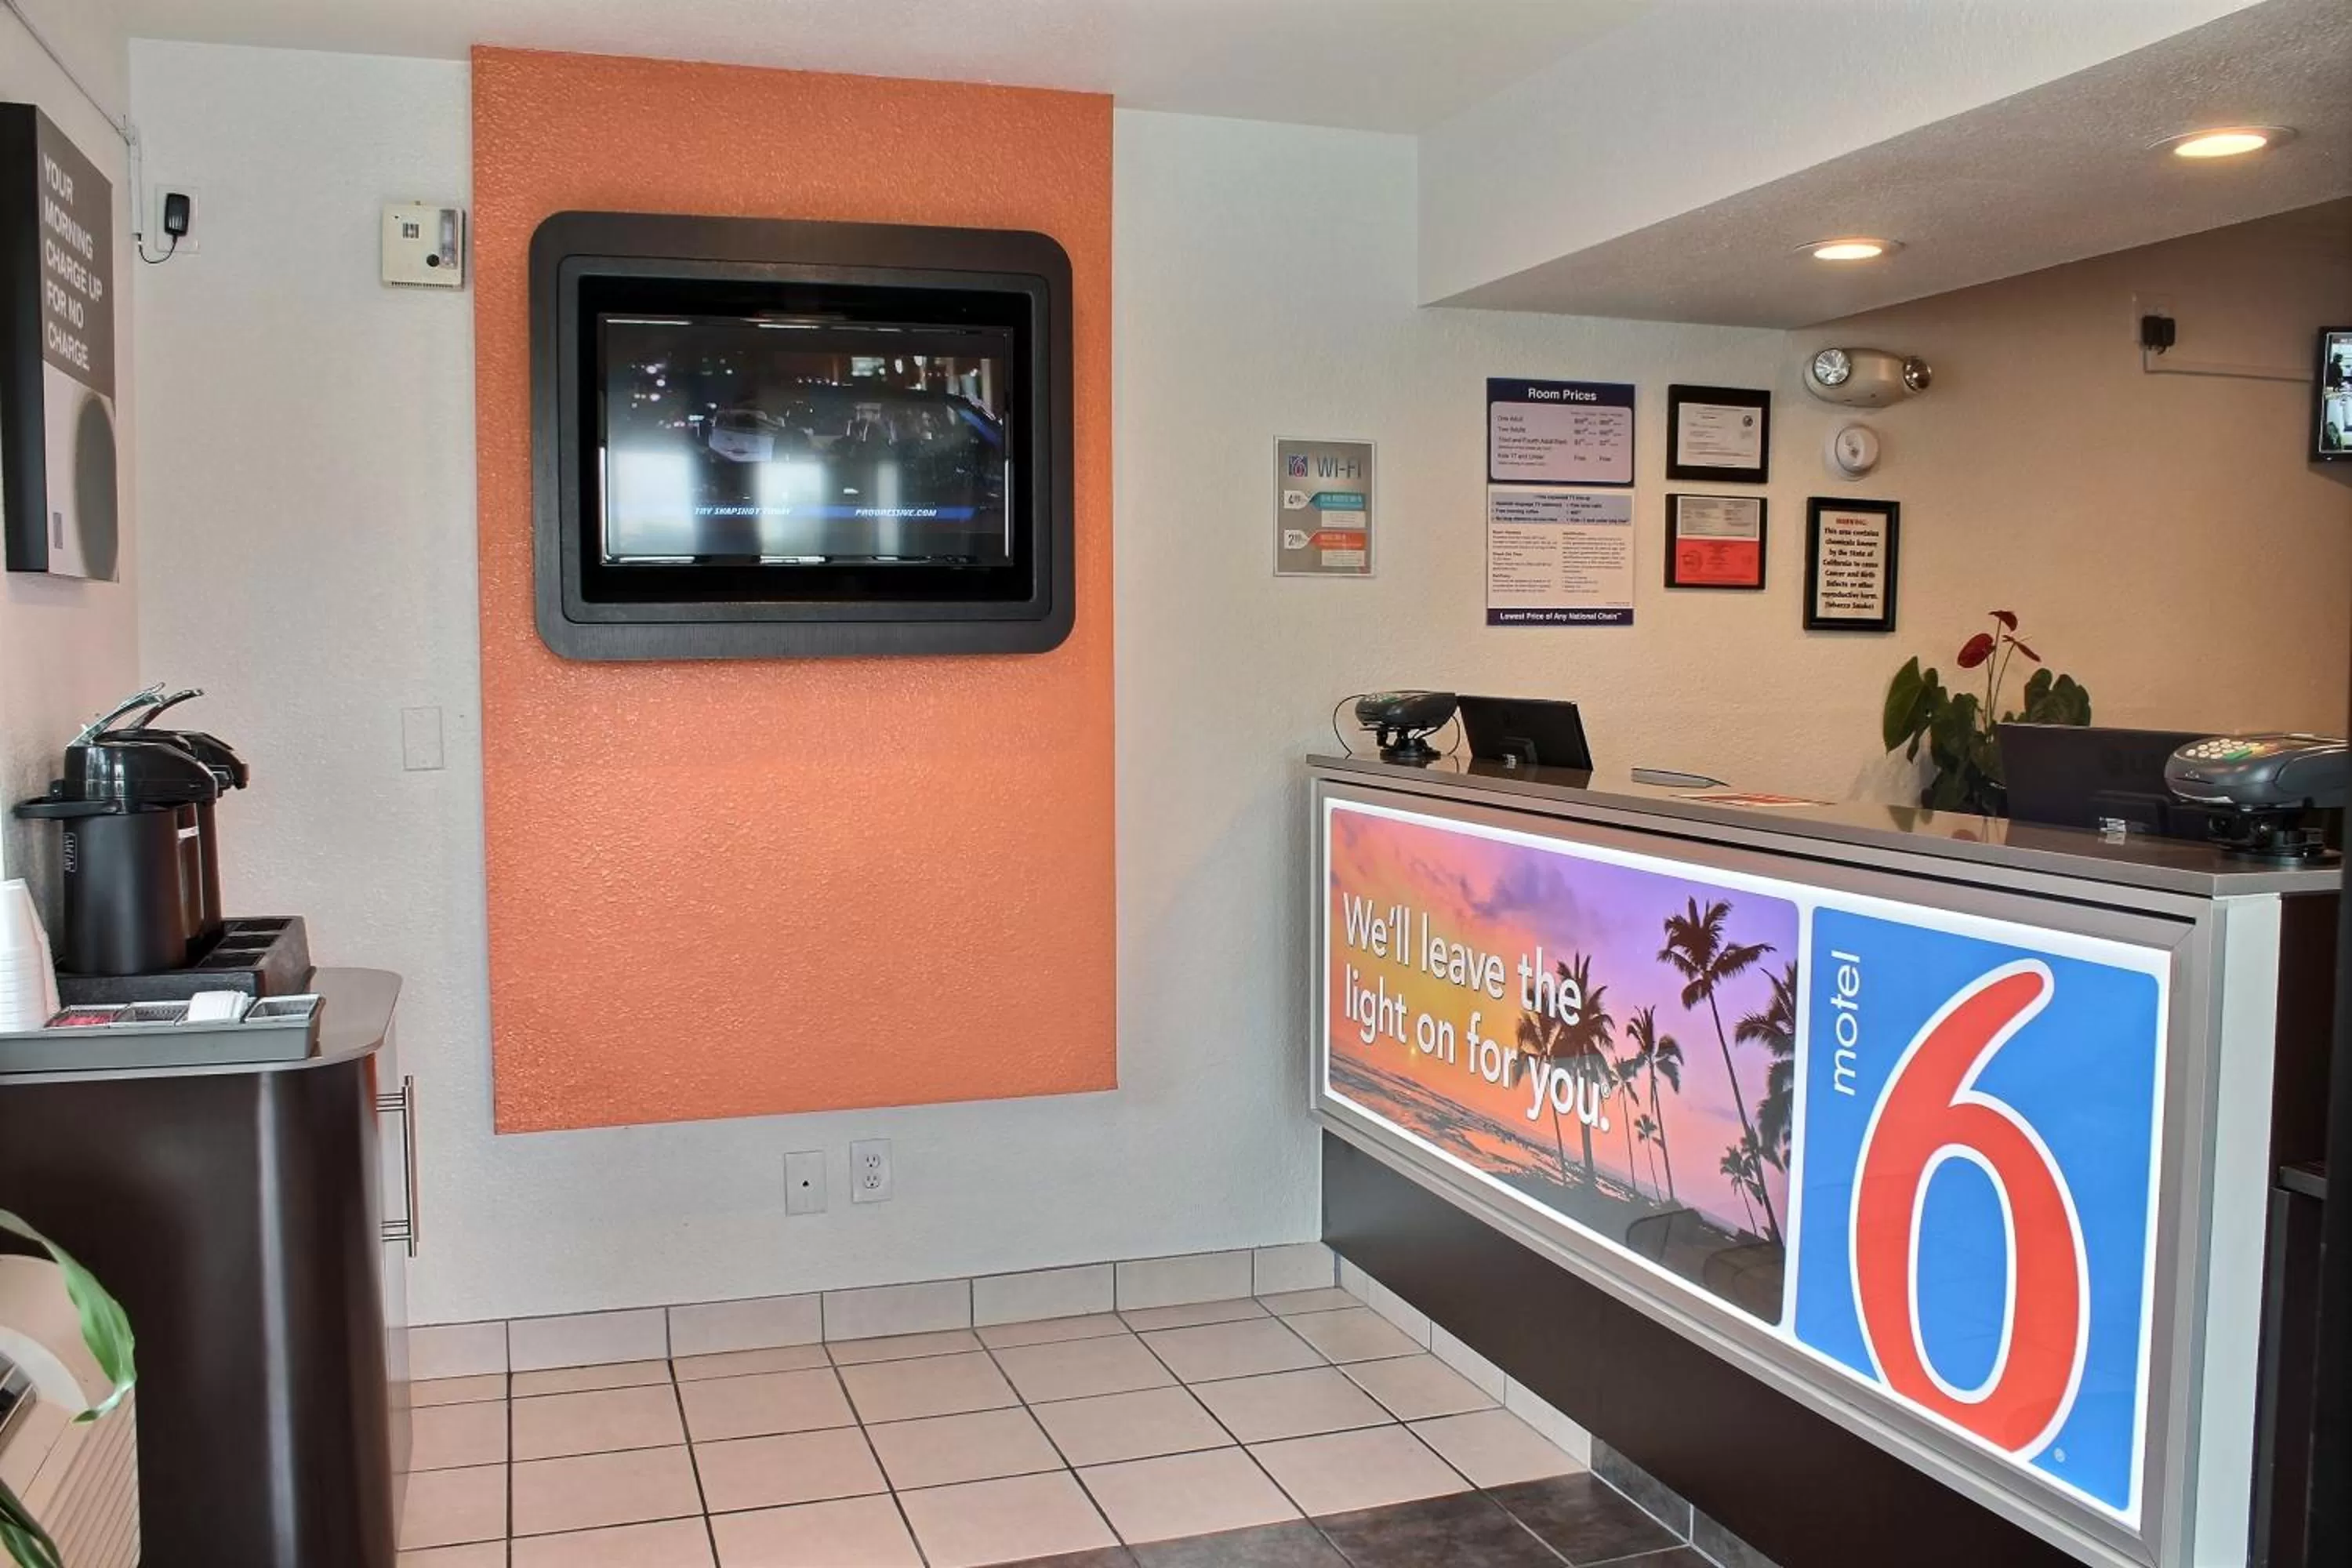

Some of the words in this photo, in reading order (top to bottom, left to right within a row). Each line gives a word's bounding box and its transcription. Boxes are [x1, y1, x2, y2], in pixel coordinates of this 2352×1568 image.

[44, 152, 73, 206] YOUR
[45, 194, 94, 259] MORNING
[46, 238, 87, 295] CHARGE
[89, 273, 103, 302] UP
[46, 278, 67, 319] FOR
[68, 295, 84, 330] NO
[1528, 387, 1560, 400] Room
[1563, 390, 1598, 401] Prices
[855, 509, 938, 517] PROGRESSIVE.COM
[1554, 613, 1567, 622] Any
[1343, 891, 1410, 966] We'll
[1421, 912, 1506, 999] leave
[1518, 946, 1582, 1026] the
[1345, 963, 1408, 1044] light
[1417, 1012, 1455, 1065] on
[1467, 1011, 1518, 1088] for
[1526, 1055, 1610, 1132] you.
[1831, 949, 1860, 1096] motel
[1848, 957, 2091, 1463] 6
